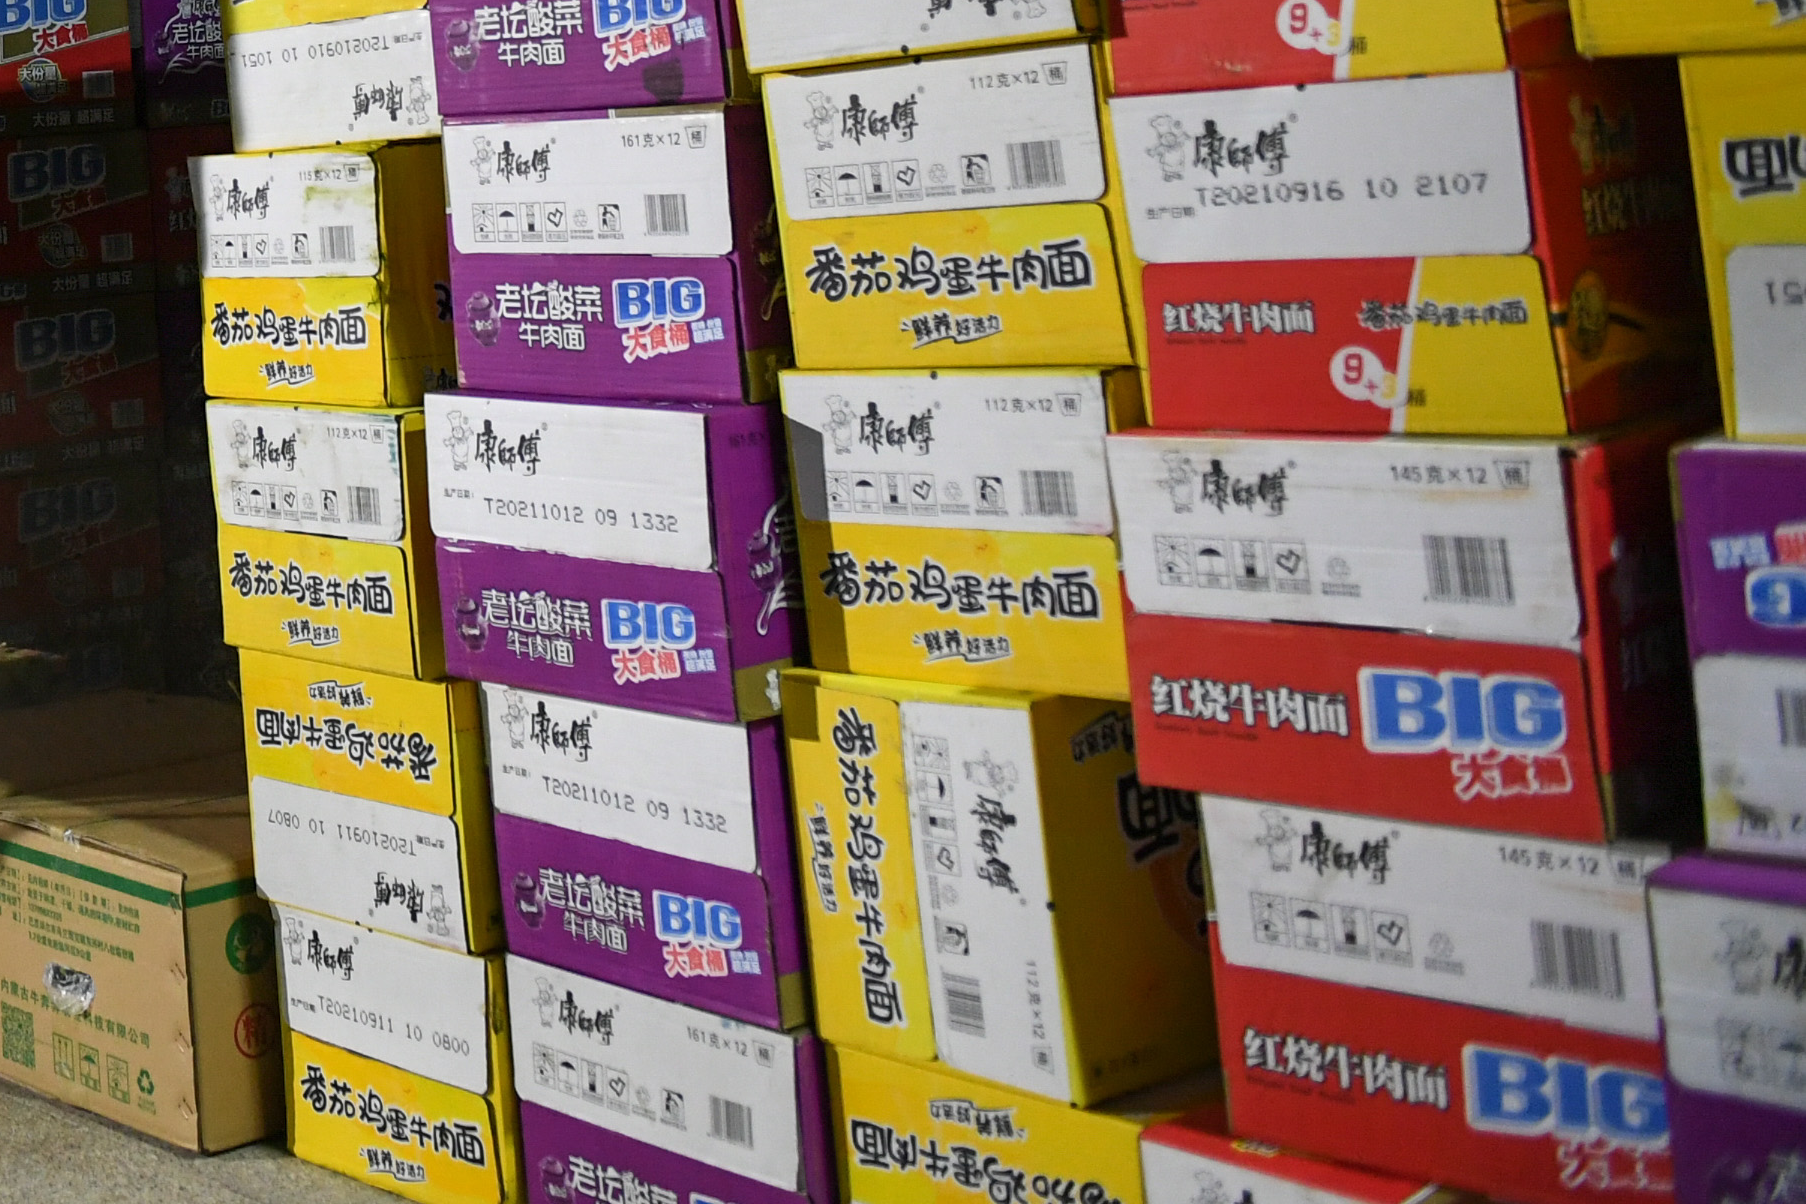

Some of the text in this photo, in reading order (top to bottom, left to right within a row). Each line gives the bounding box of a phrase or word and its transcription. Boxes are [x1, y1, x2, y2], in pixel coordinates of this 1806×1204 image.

[241, 34, 390, 69] T20210910 10 1051
[497, 39, 565, 67] 牛肉面
[603, 24, 672, 72] 大食桶
[7, 144, 106, 205] BIG
[1196, 172, 1489, 209] T20210916 10 2107
[805, 238, 1093, 303] 番茄鸡蛋牛肉面
[210, 302, 368, 348] 番茄鸡蛋牛肉面
[495, 280, 604, 323] 老坛酸菜
[611, 277, 706, 329] BIG
[1162, 299, 1316, 336] 红烧牛肉面
[1358, 299, 1530, 333] 番茄鸡蛋牛肉面
[519, 322, 586, 352] 牛肉面
[622, 321, 691, 364] 大食桶
[910, 312, 1002, 341] 鲜养好活力
[484, 497, 679, 534] T20211012 09 1332
[229, 552, 394, 615] 番茄鸡蛋牛肉面
[819, 551, 1102, 620] 番茄鸡蛋牛肉面
[480, 589, 594, 642] 老坛酸菜
[601, 597, 696, 650] BIG
[506, 630, 575, 668] 牛肉面
[612, 648, 682, 685] 大食桶
[1150, 674, 1350, 739] 红烧牛肉面
[1357, 666, 1567, 754] BIG
[256, 708, 438, 782] 番茄鸡蛋牛肉面
[309, 818, 325, 835] 10
[543, 774, 728, 834] T20211012 09 1332
[337, 823, 417, 857] T20210911
[829, 706, 903, 1029] 番茄鸡蛋牛肉面
[537, 866, 646, 932] 老坛酸菜
[652, 888, 743, 950] BIG
[563, 911, 630, 955] 牛肉面
[663, 942, 729, 979] 大食桶
[317, 994, 395, 1034] T20210911
[405, 1022, 423, 1044] 10
[1244, 1026, 1449, 1112] 红烧牛肉面
[1462, 1042, 1671, 1143] BIG
[300, 1064, 487, 1168] 番茄鸡蛋牛肉面
